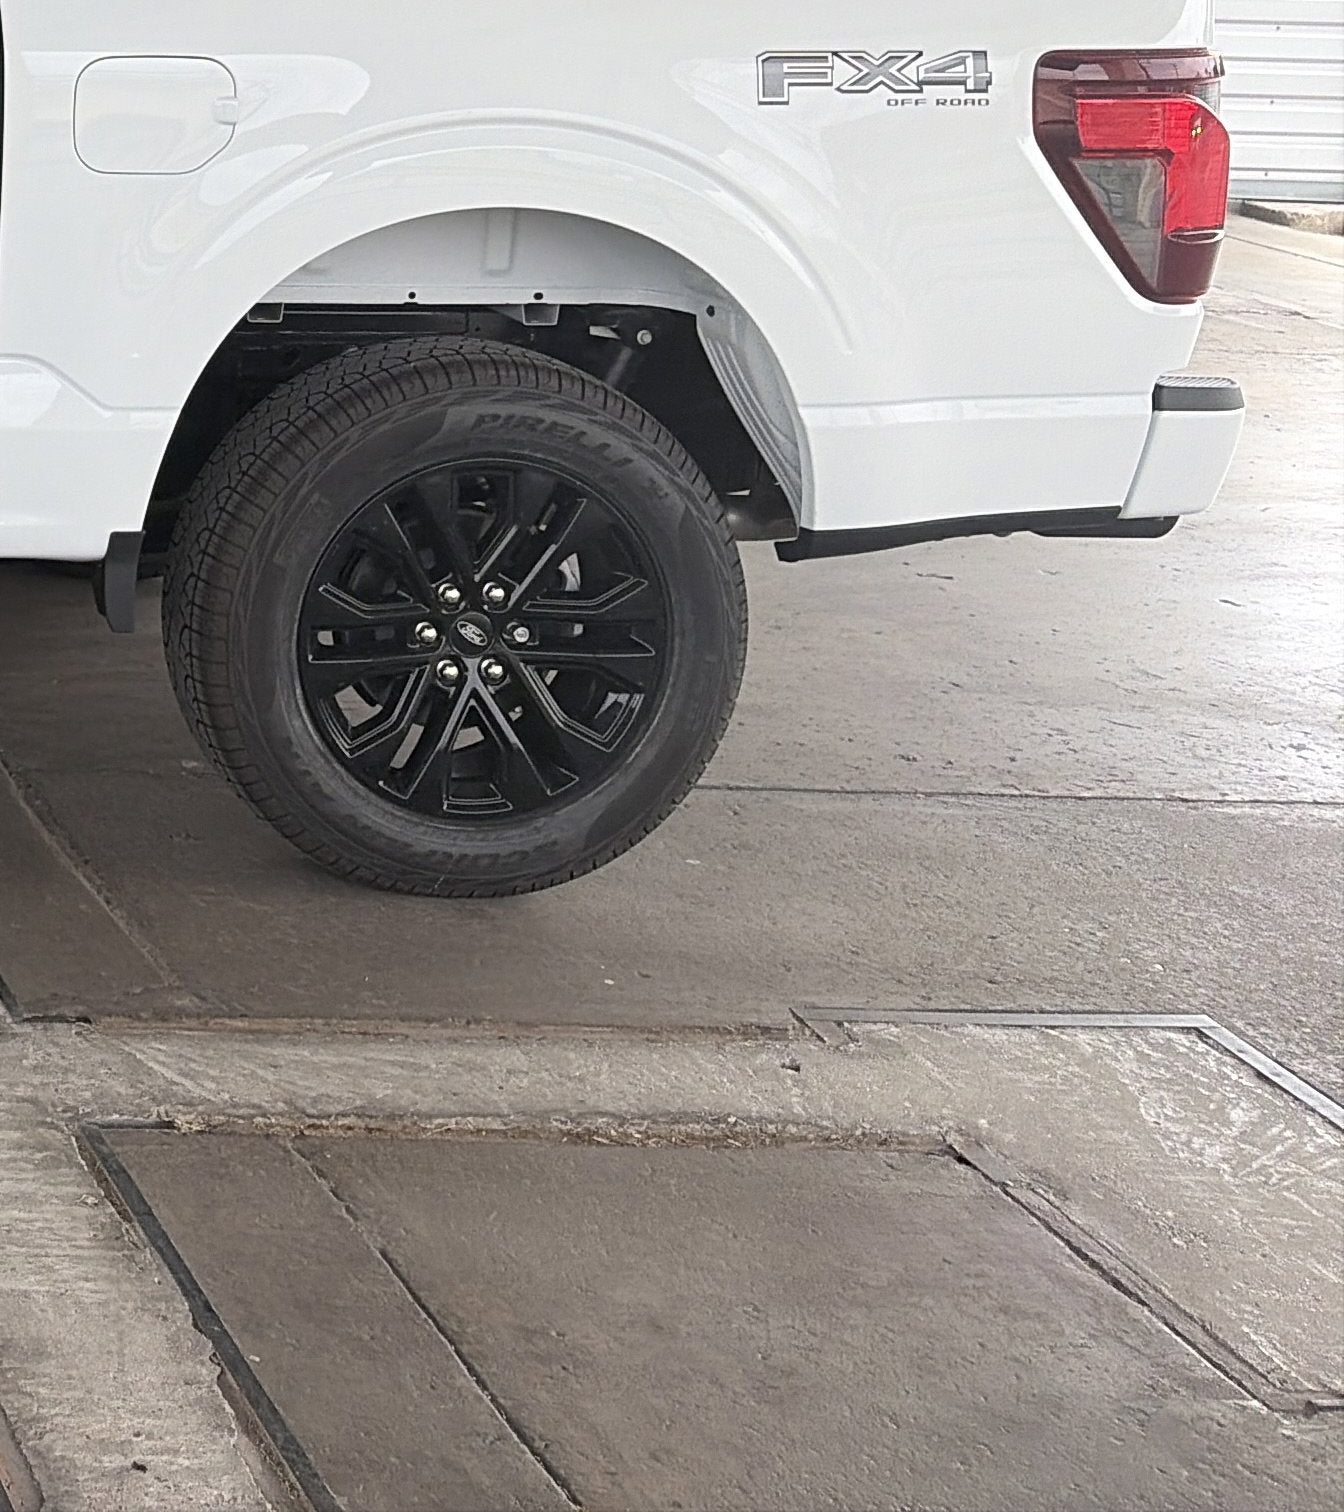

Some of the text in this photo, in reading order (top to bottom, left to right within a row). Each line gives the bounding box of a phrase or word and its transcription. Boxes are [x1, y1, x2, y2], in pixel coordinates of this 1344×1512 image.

[756, 50, 993, 106] FX4
[886, 98, 990, 107] OFF ROAD
[470, 412, 634, 468] PIRELLI
